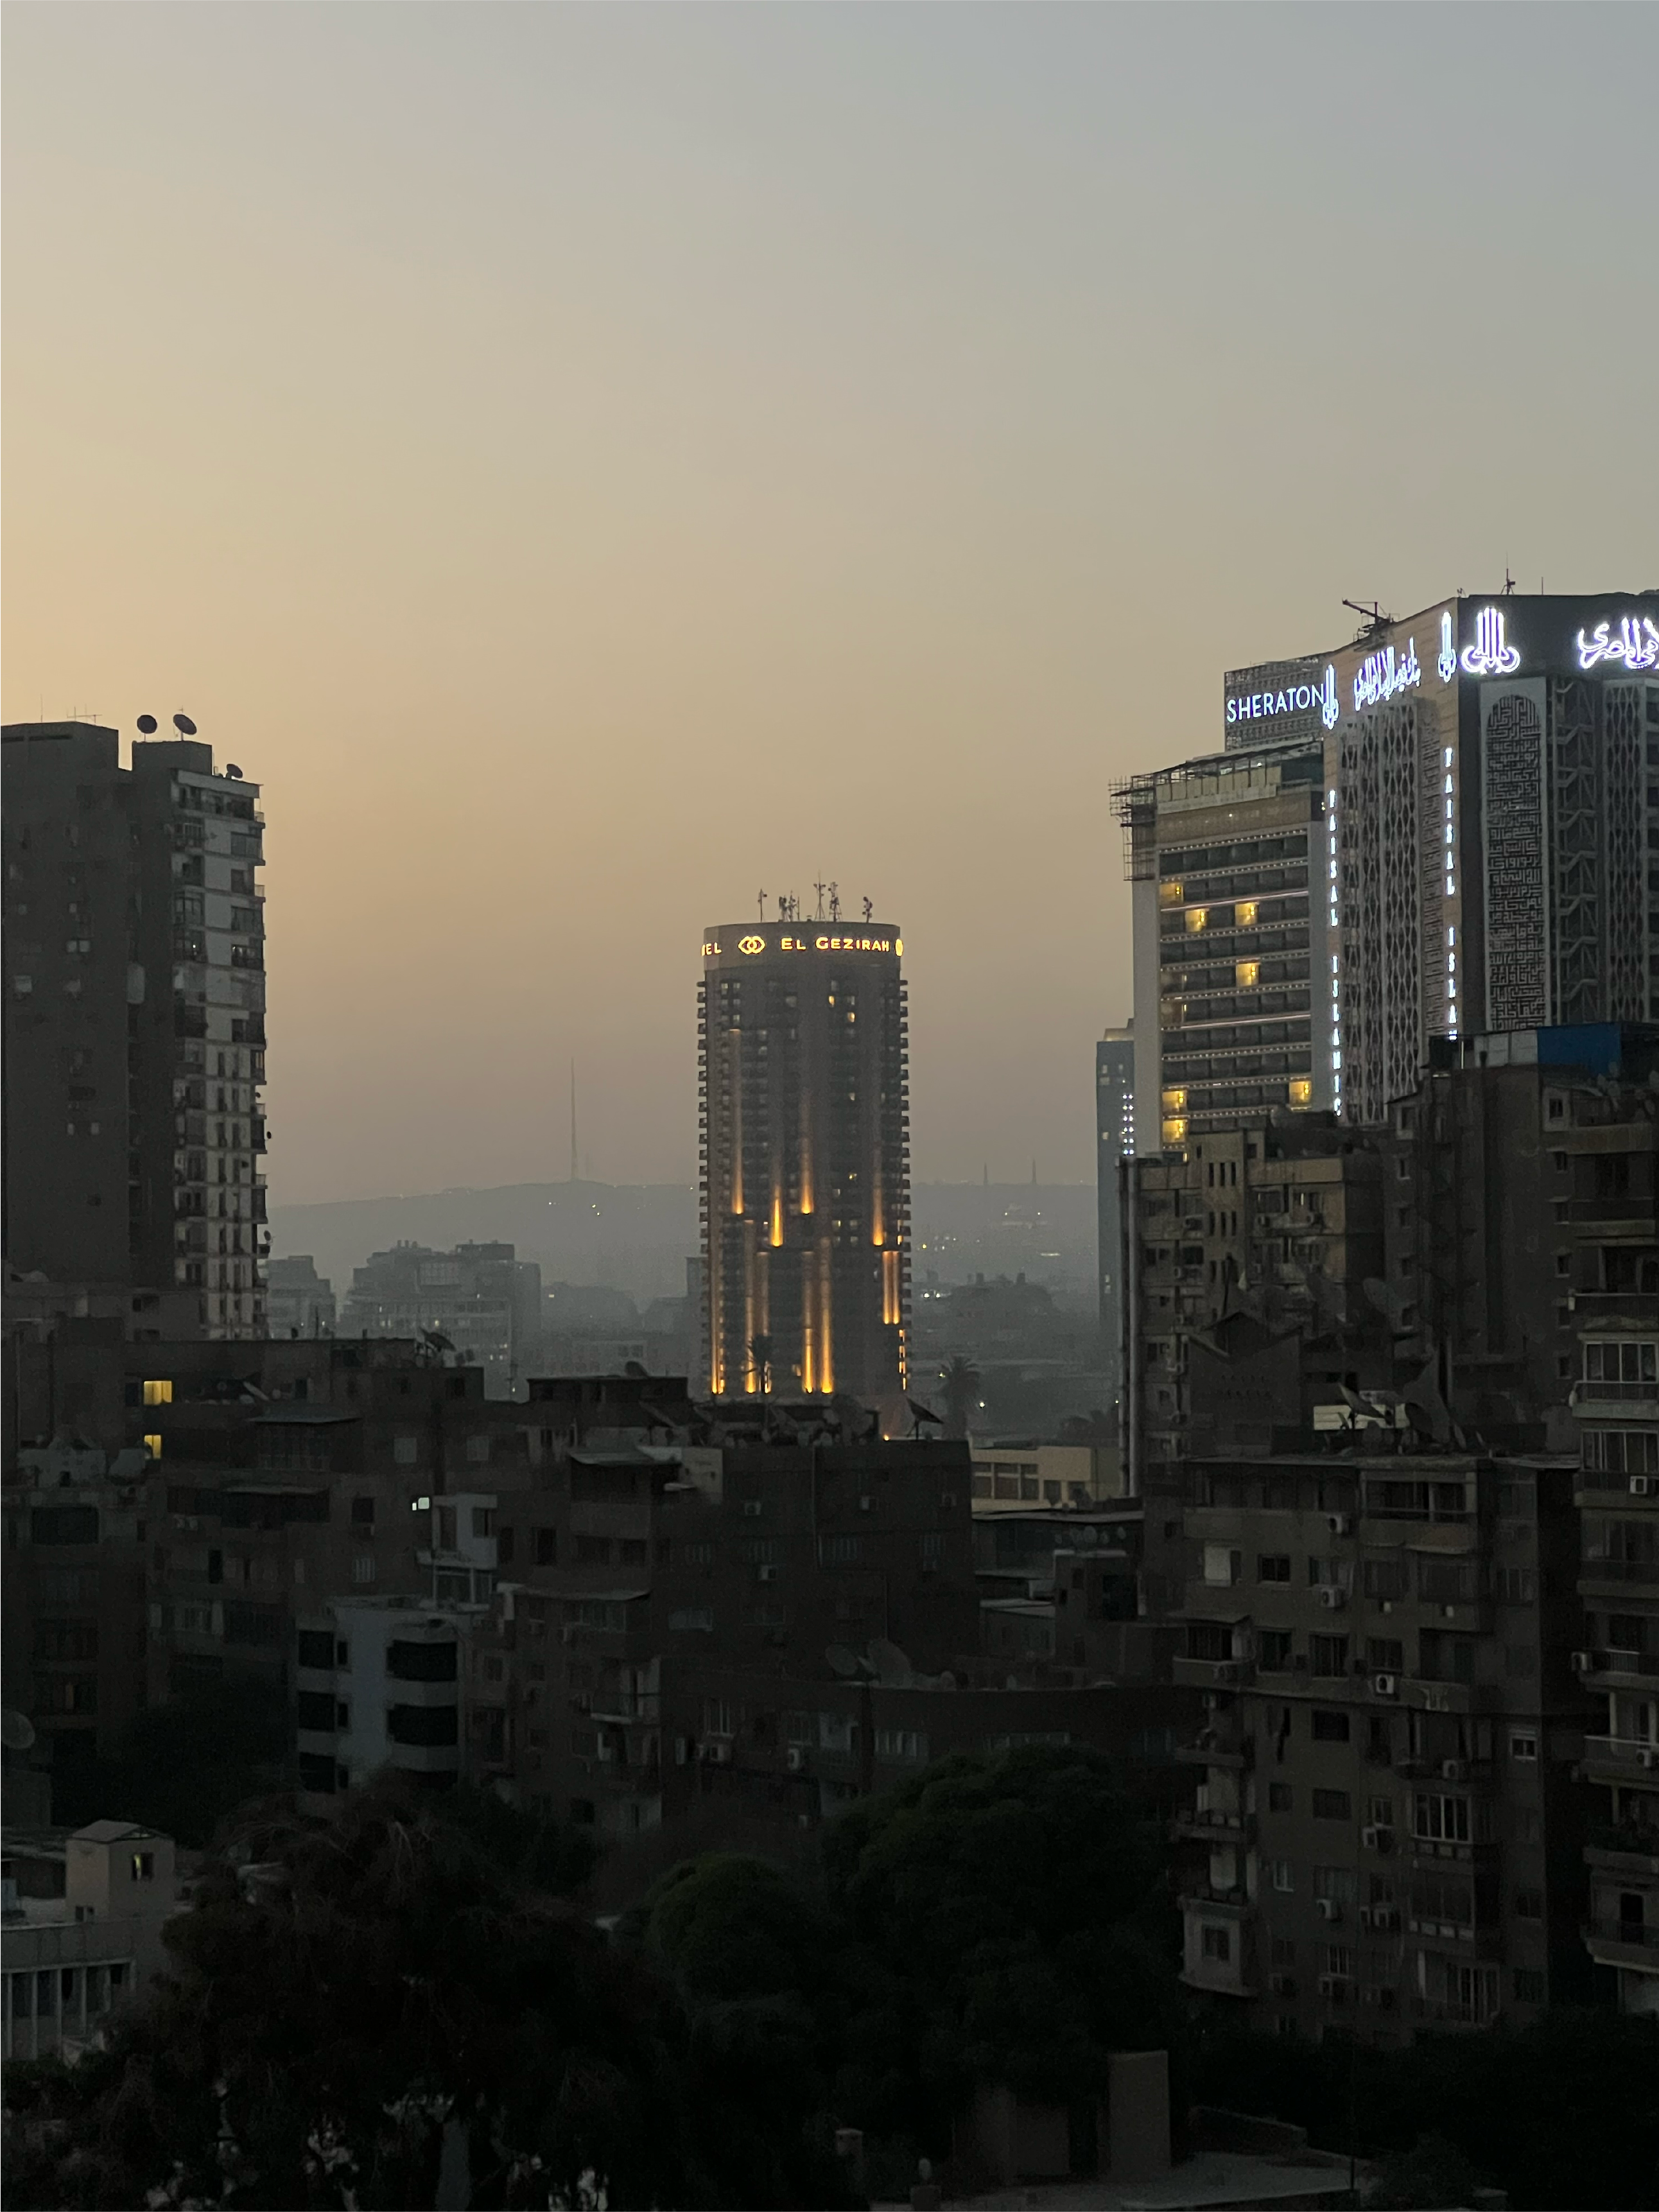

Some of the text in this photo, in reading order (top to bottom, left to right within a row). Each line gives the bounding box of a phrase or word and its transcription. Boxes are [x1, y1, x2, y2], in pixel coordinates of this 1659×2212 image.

[1226, 683, 1324, 723] SHERATON
[781, 937, 806, 950] EL
[815, 936, 889, 952] GEZIRAH
